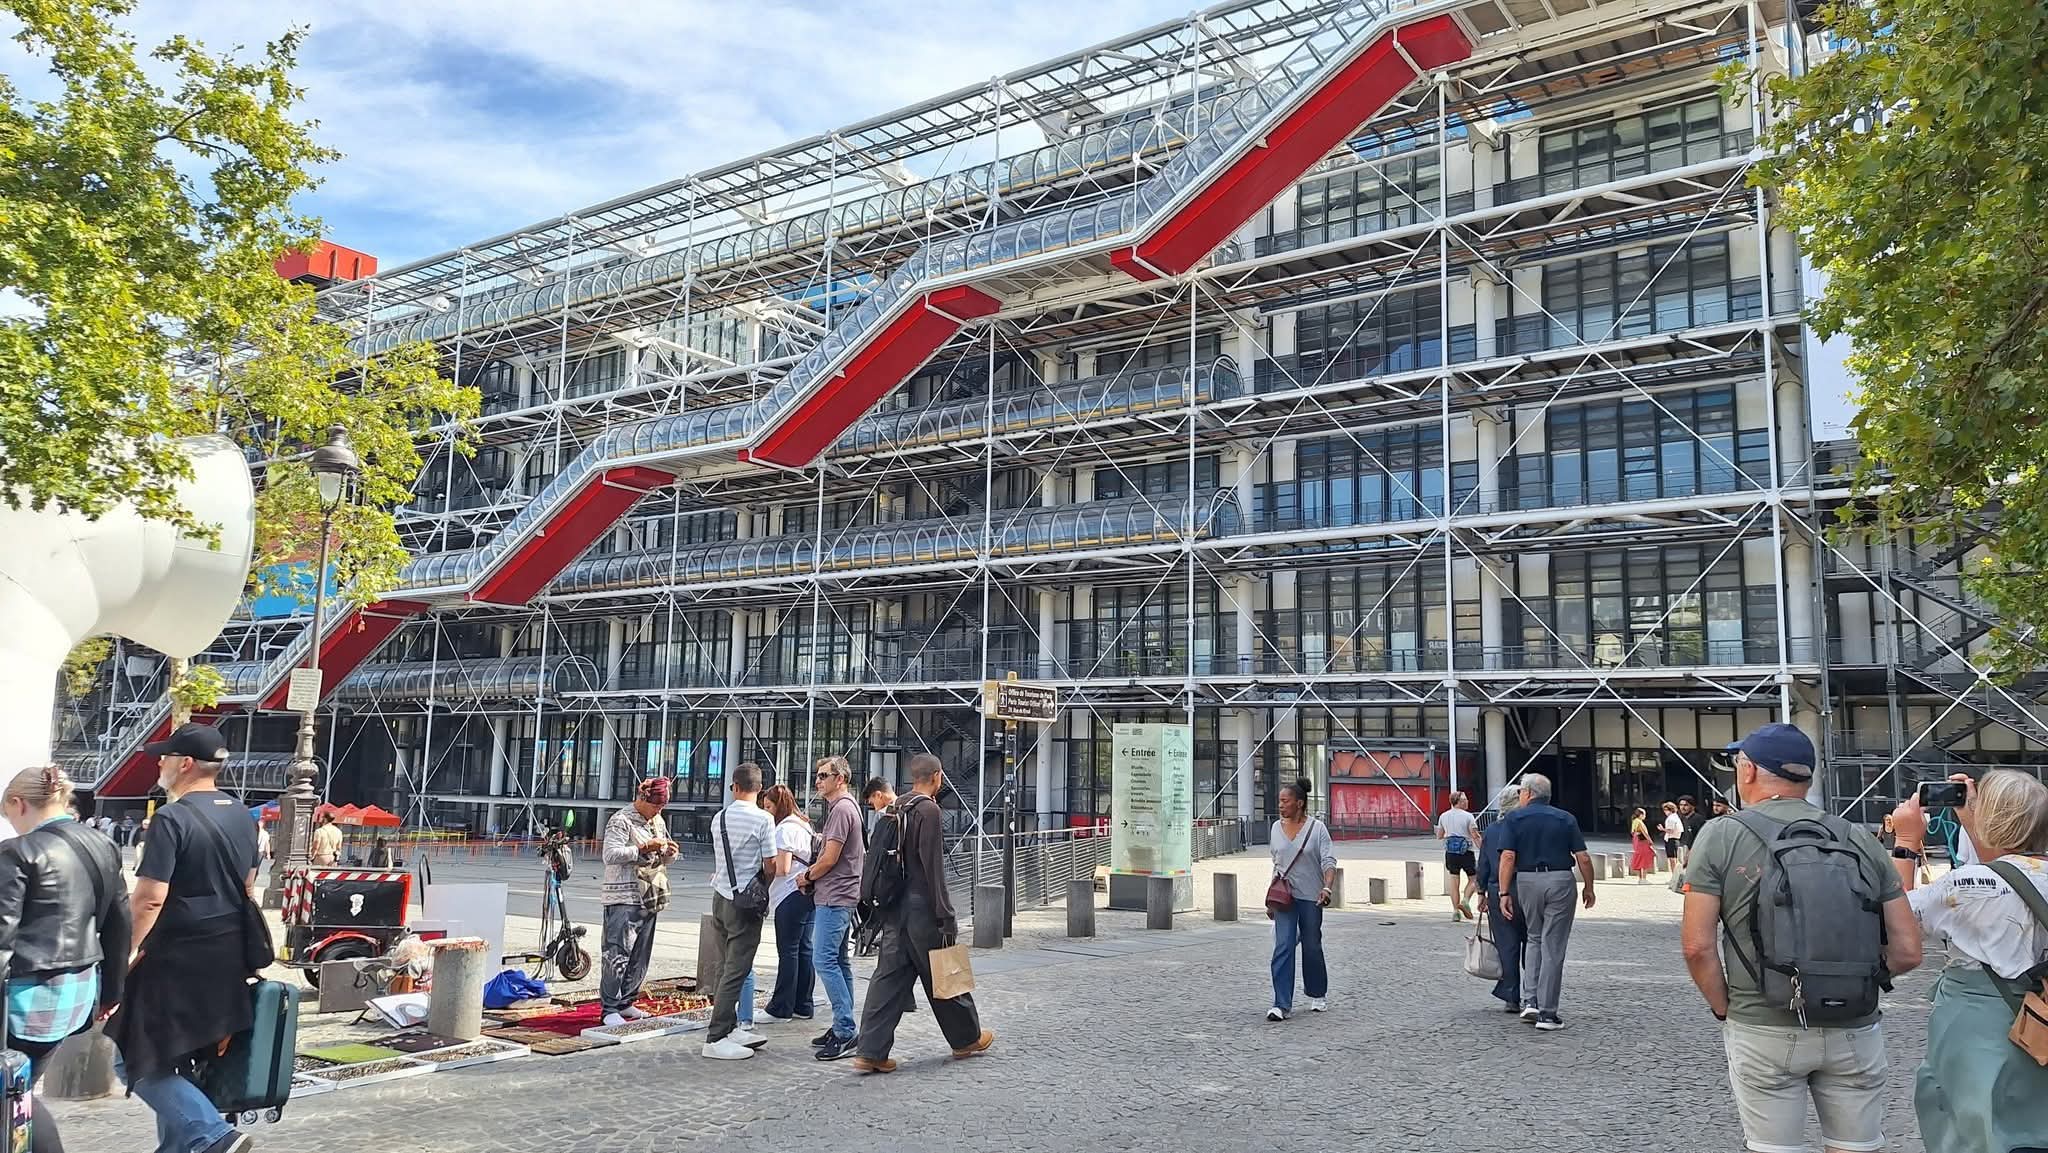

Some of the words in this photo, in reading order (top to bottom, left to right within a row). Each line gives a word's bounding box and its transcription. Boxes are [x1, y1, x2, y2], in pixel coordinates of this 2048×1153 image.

[1131, 746, 1156, 757] Entrée
[1096, 818, 1111, 836] Li
[1958, 878, 1975, 886] LOVE
[1976, 878, 1997, 886] WHO
